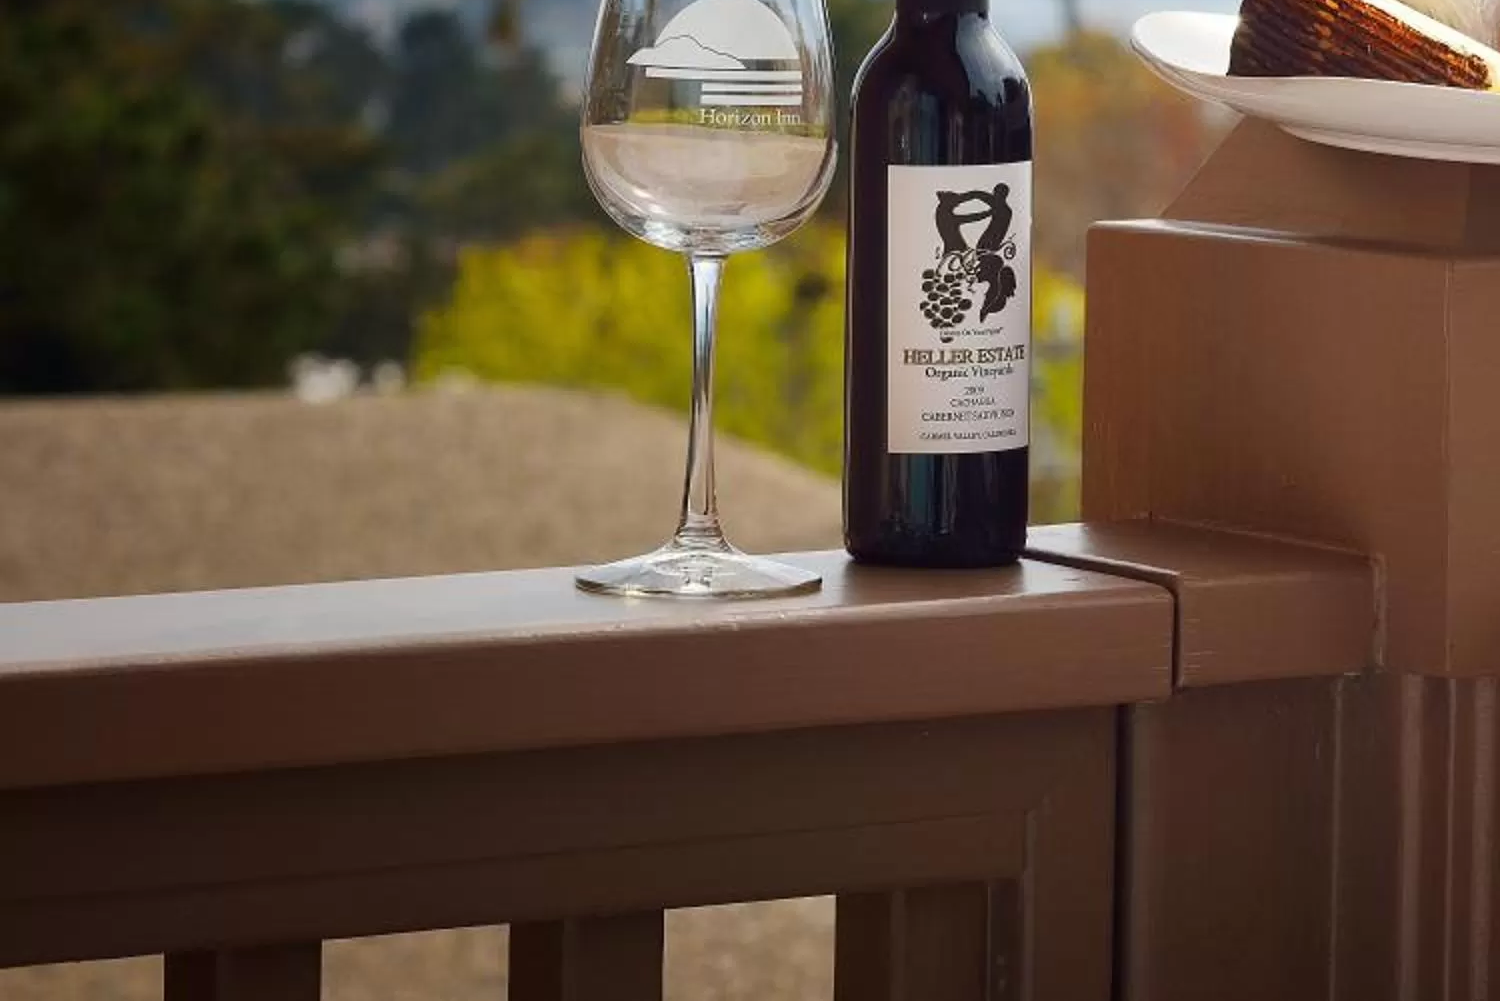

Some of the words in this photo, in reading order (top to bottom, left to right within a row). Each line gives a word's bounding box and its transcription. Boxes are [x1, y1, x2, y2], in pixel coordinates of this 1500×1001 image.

[700, 108, 771, 125] Horizon
[776, 109, 801, 125] Inn
[903, 349, 974, 365] HELLER
[976, 344, 1025, 363] ESTATE
[925, 366, 969, 381] Organic
